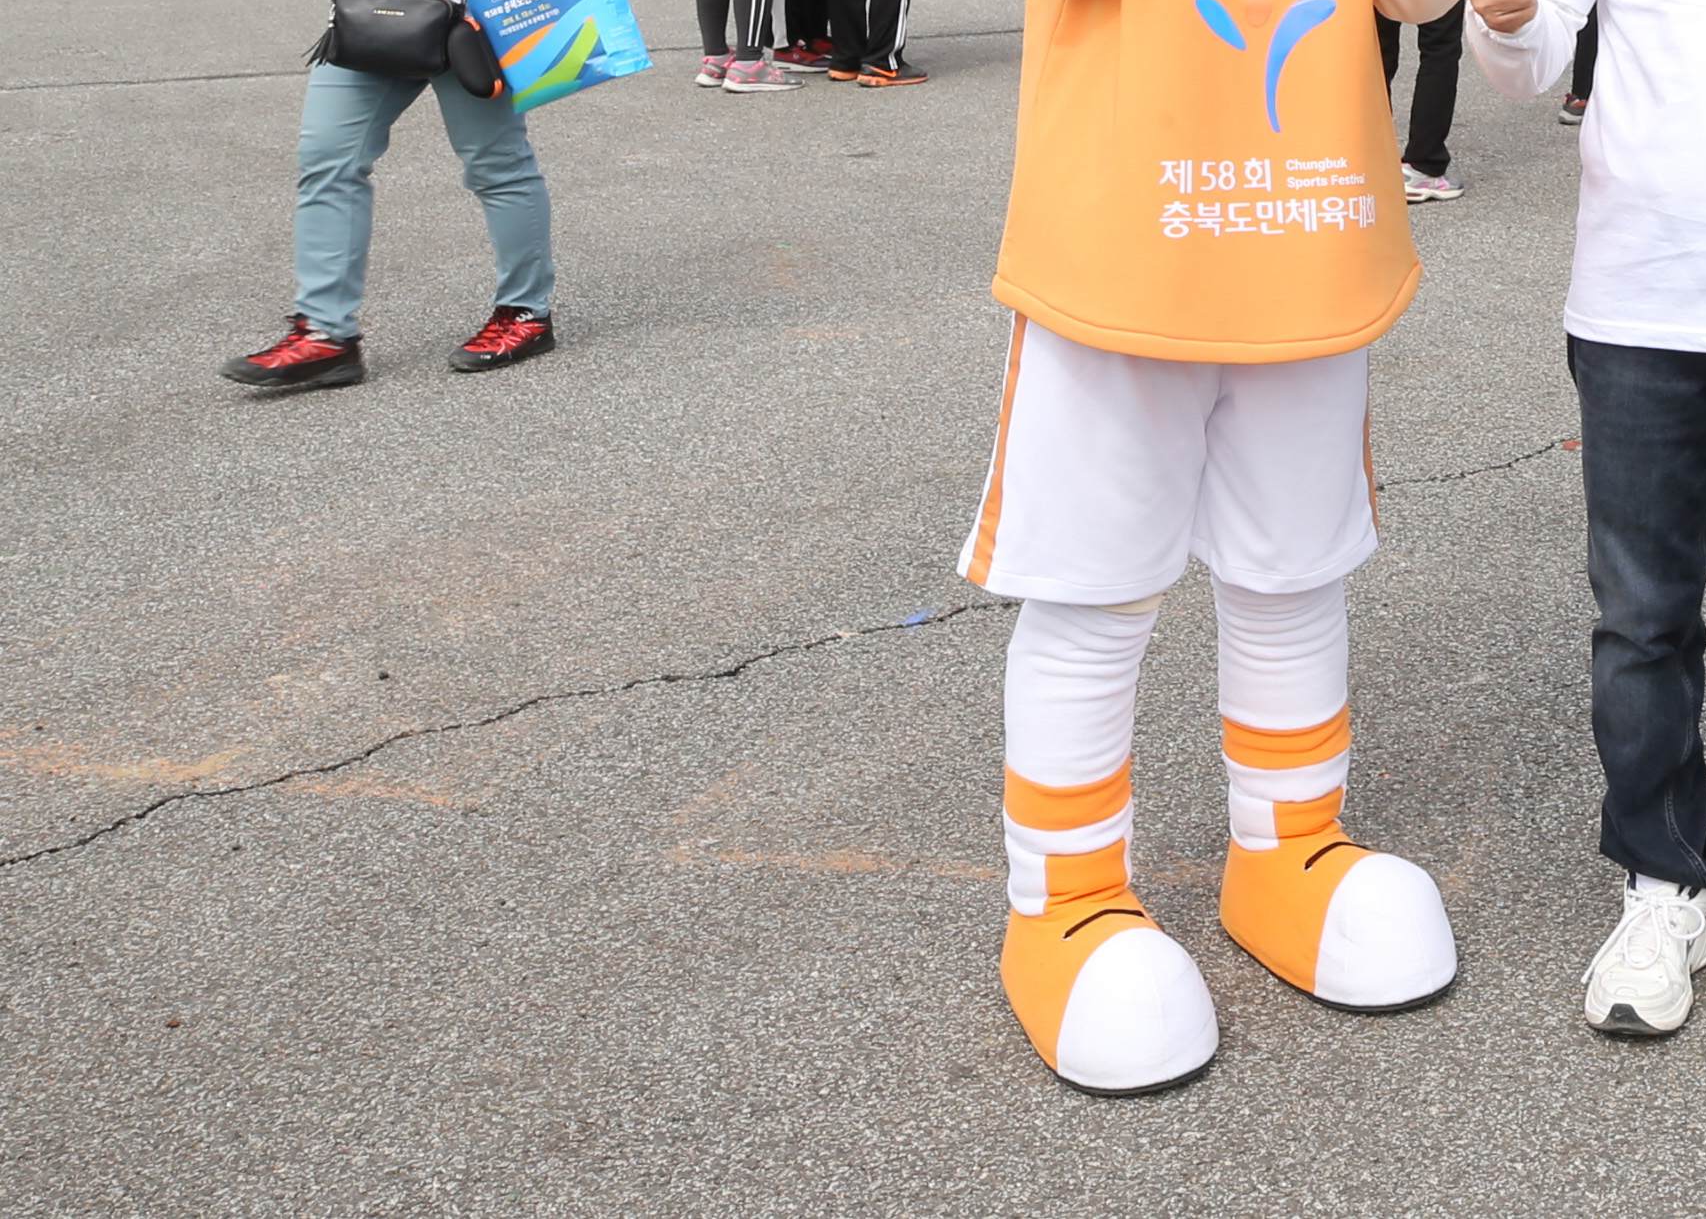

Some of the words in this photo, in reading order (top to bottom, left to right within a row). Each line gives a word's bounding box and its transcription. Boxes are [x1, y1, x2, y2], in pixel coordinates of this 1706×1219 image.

[1285, 157, 1348, 172] Chungbuk
[1287, 176, 1328, 190] Sports
[1331, 172, 1366, 186] Festival
[1158, 194, 1377, 239] 충북도민체육대회
